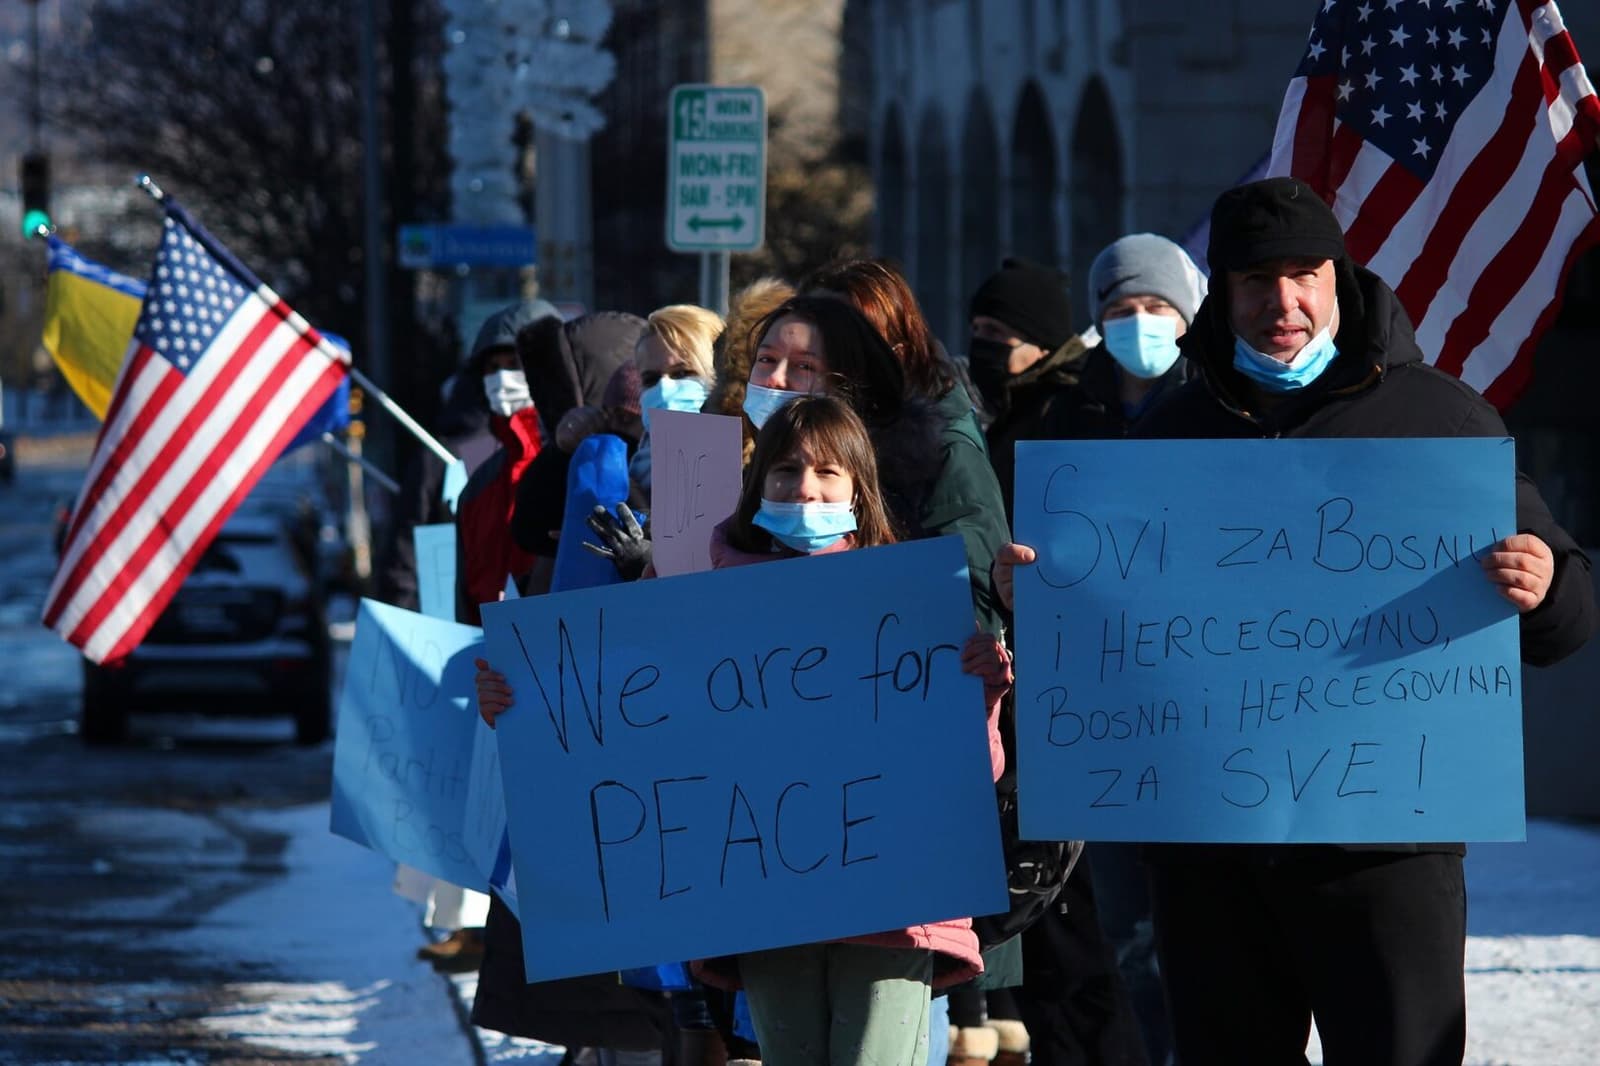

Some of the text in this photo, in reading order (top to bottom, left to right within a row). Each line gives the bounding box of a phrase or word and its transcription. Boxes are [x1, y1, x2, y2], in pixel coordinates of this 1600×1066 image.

[680, 98, 752, 138] 15 MIN
[680, 153, 757, 177] MON-FRI
[511, 607, 960, 754] We are for
[1239, 663, 1514, 734] HERCEGOVINA
[1088, 765, 1161, 809] ZA
[589, 774, 882, 923] PEACE
